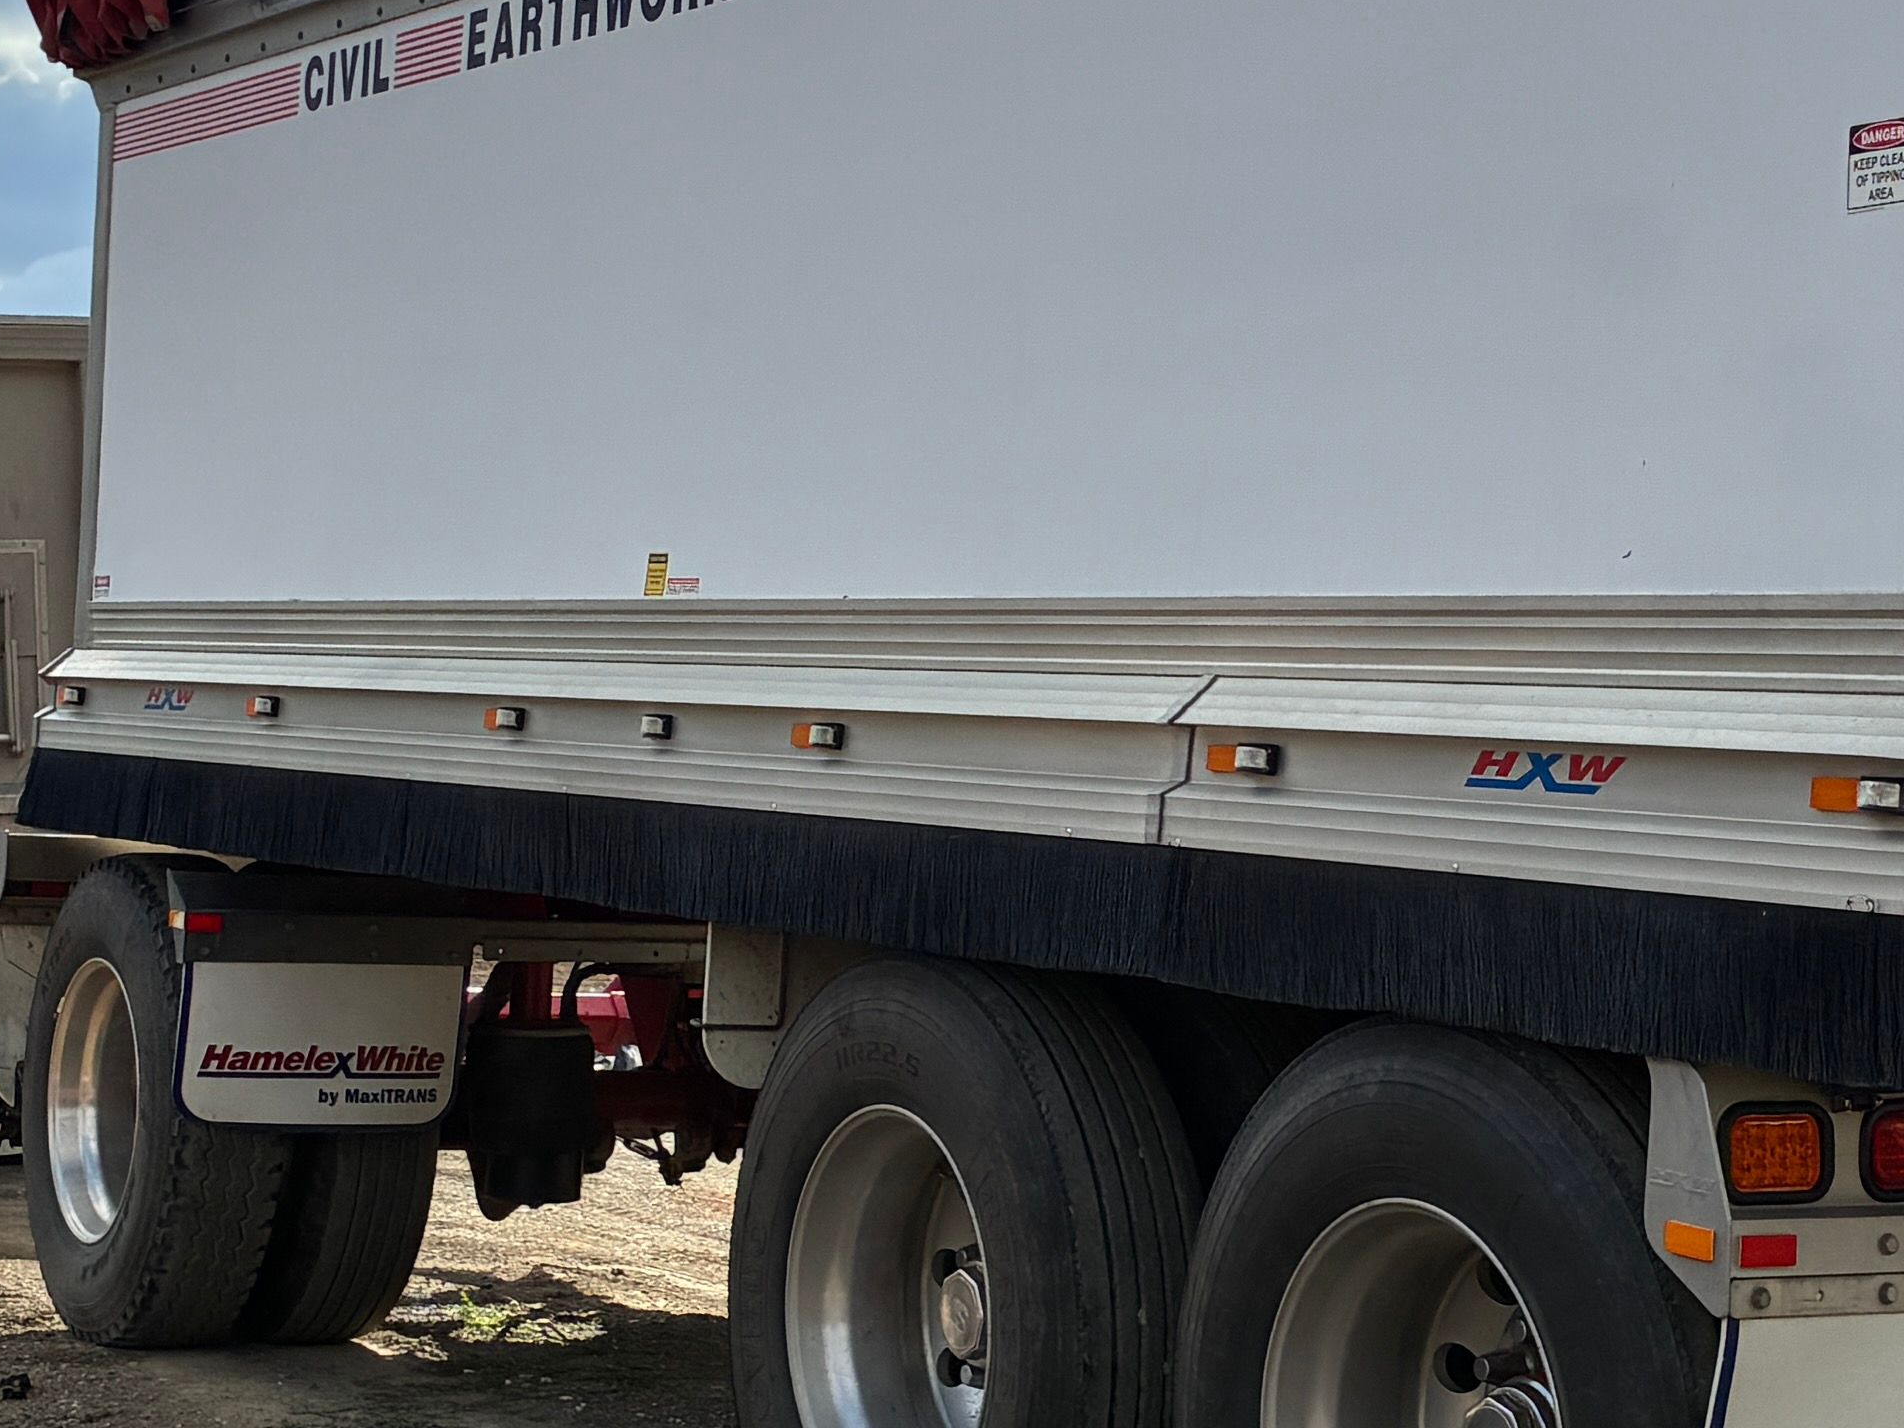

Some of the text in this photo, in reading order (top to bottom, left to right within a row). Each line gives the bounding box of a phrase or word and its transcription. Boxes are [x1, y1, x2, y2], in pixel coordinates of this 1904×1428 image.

[304, 37, 391, 112] CIVIL
[1861, 126, 1904, 145] DANGER
[1854, 156, 1878, 172] KEEP
[1856, 174, 1869, 187] OF
[1868, 187, 1894, 201] AREA
[146, 687, 194, 709] HXW
[1466, 749, 1627, 786] HXW
[199, 1045, 445, 1074] HamelexWhite
[318, 1088, 338, 1106] by
